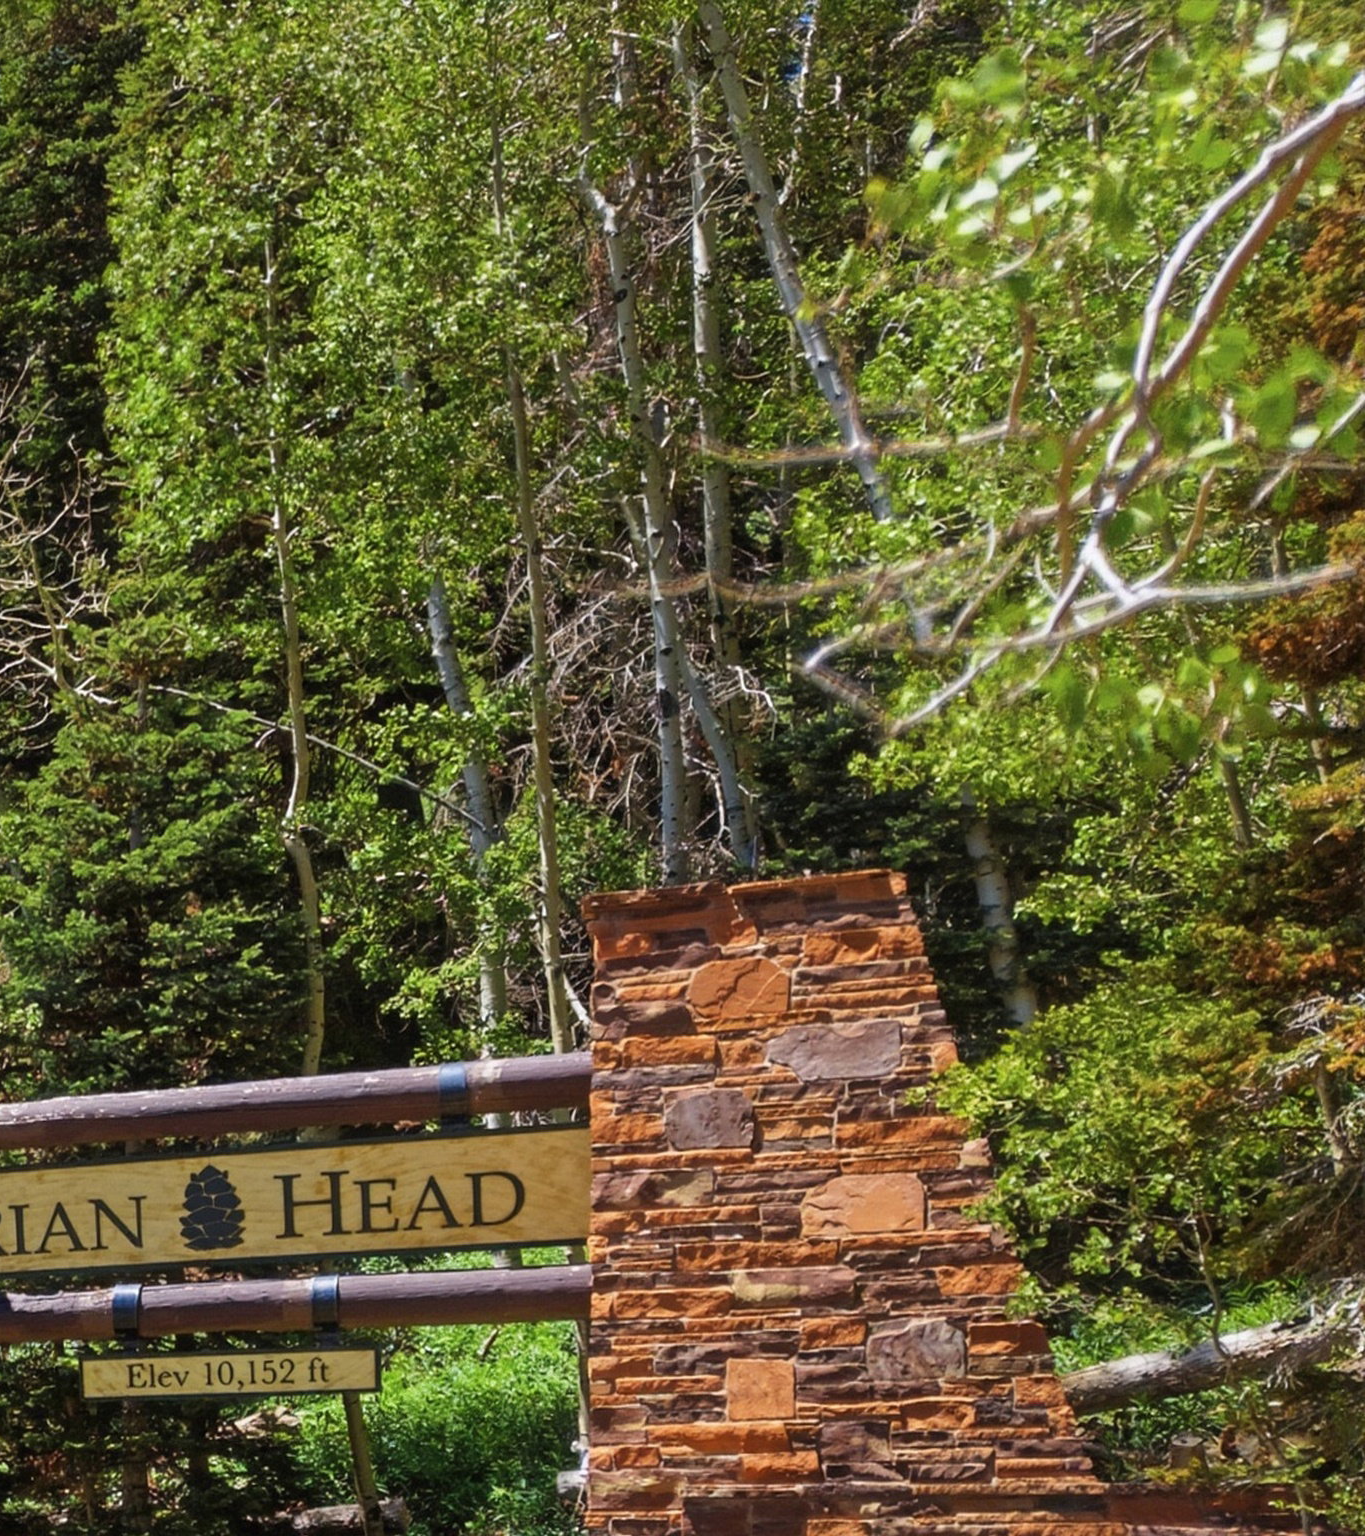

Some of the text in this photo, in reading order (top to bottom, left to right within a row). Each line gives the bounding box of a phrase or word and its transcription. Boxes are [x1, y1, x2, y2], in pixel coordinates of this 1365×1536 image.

[273, 1170, 525, 1239] HEAD
[125, 1357, 330, 1391] Elev 10,152 ft
